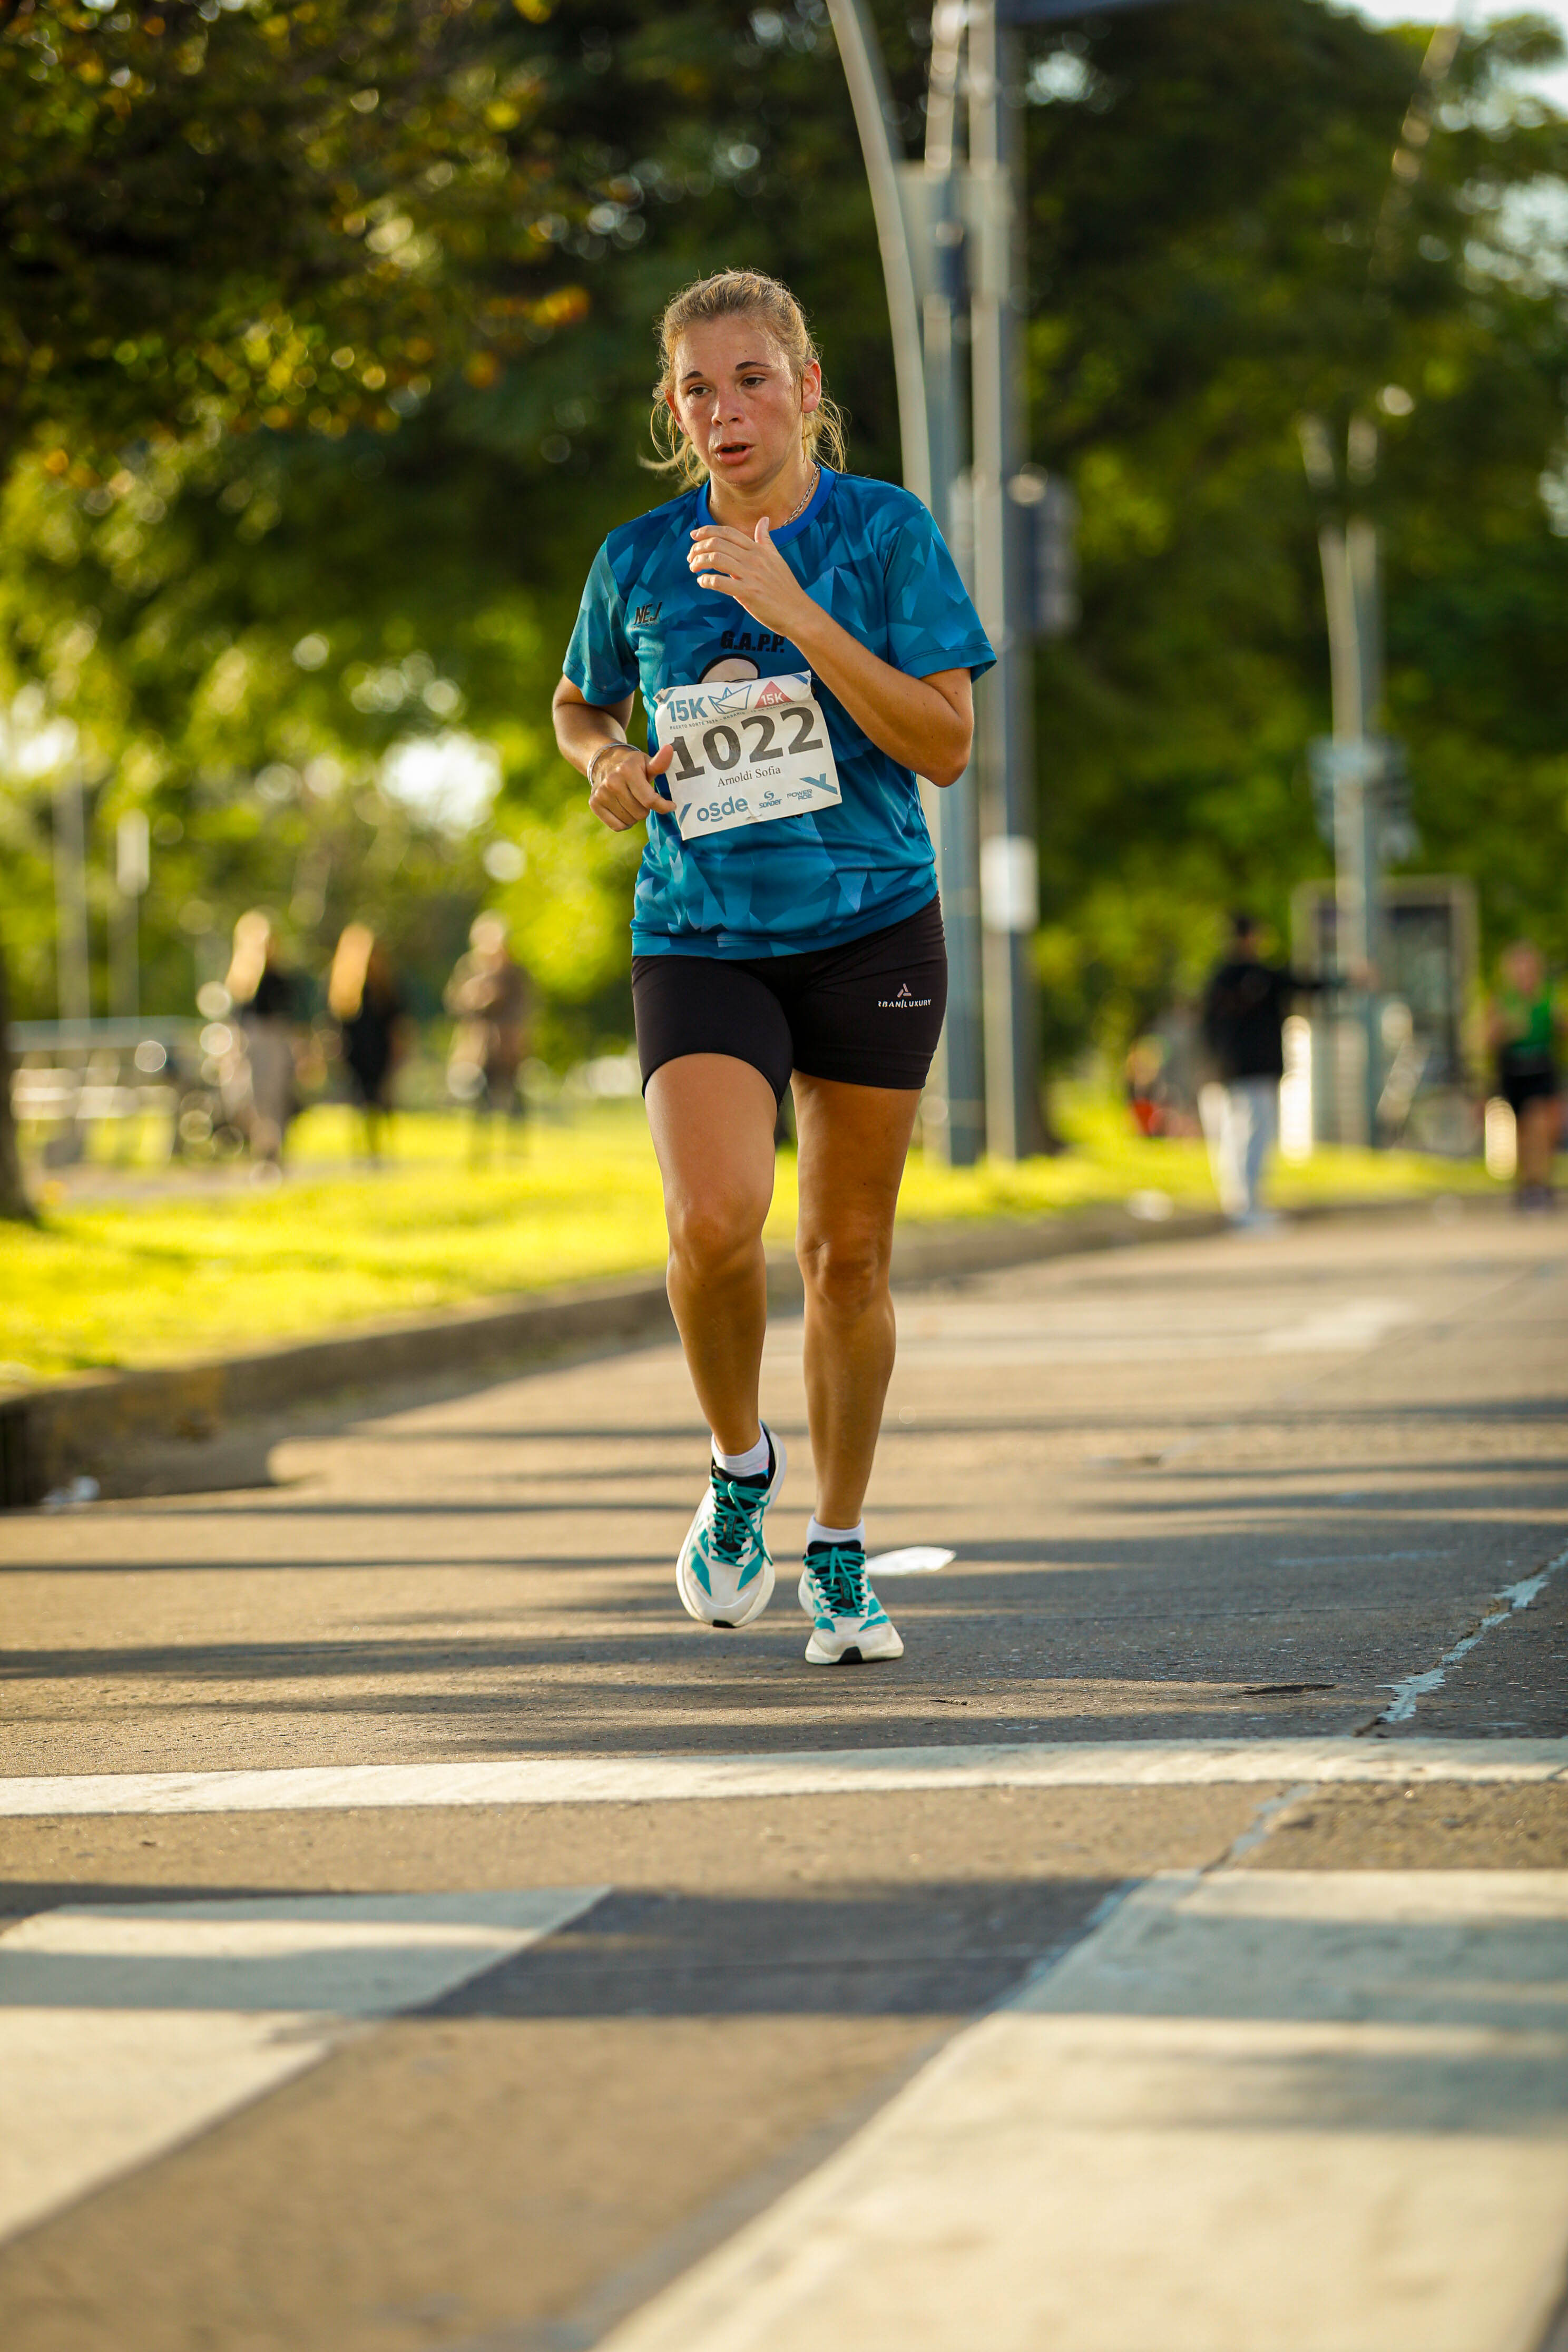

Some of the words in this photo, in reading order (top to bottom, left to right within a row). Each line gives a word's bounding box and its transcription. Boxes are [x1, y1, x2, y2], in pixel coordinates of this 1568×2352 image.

[667, 697, 709, 722] 15K
[761, 692, 785, 705] 15K
[669, 707, 824, 781] 1022
[718, 770, 752, 787] Arnoldi
[755, 766, 781, 778] Sofia
[787, 789, 812, 799] POWER
[697, 796, 748, 822] osde
